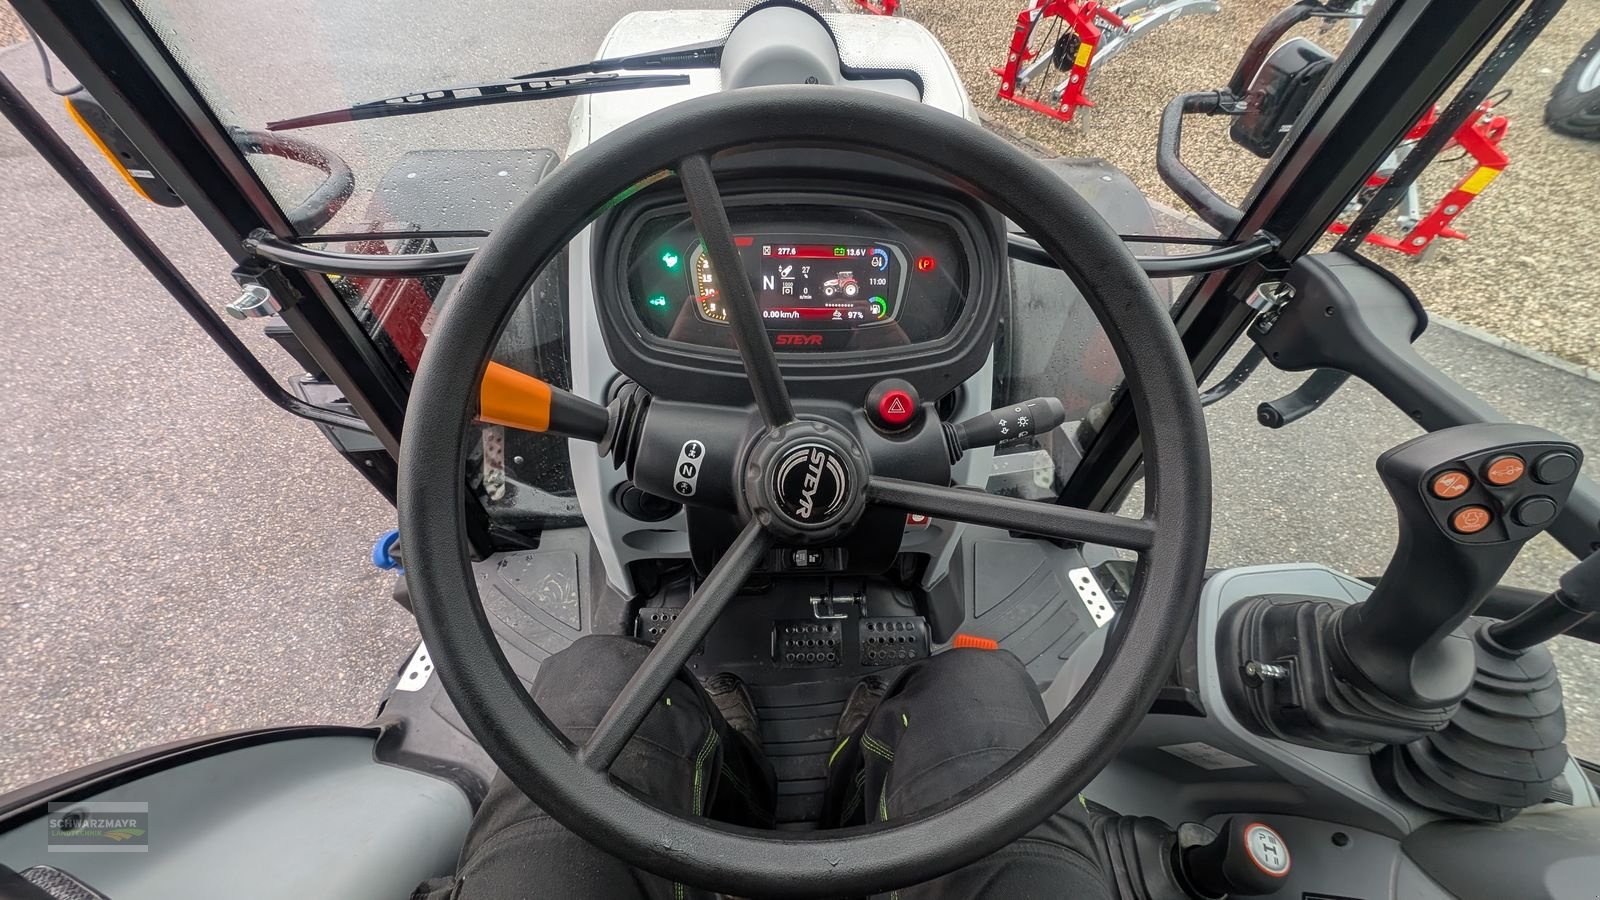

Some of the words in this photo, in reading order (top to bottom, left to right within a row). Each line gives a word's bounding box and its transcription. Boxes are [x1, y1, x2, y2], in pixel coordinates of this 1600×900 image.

[702, 274, 712, 282] 15
[763, 275, 775, 290] N
[710, 303, 716, 312] 5
[762, 310, 780, 318] 0.00
[780, 310, 800, 318] km/h
[776, 334, 823, 345] STEYR
[682, 464, 693, 477] N
[796, 448, 826, 519] STEYR
